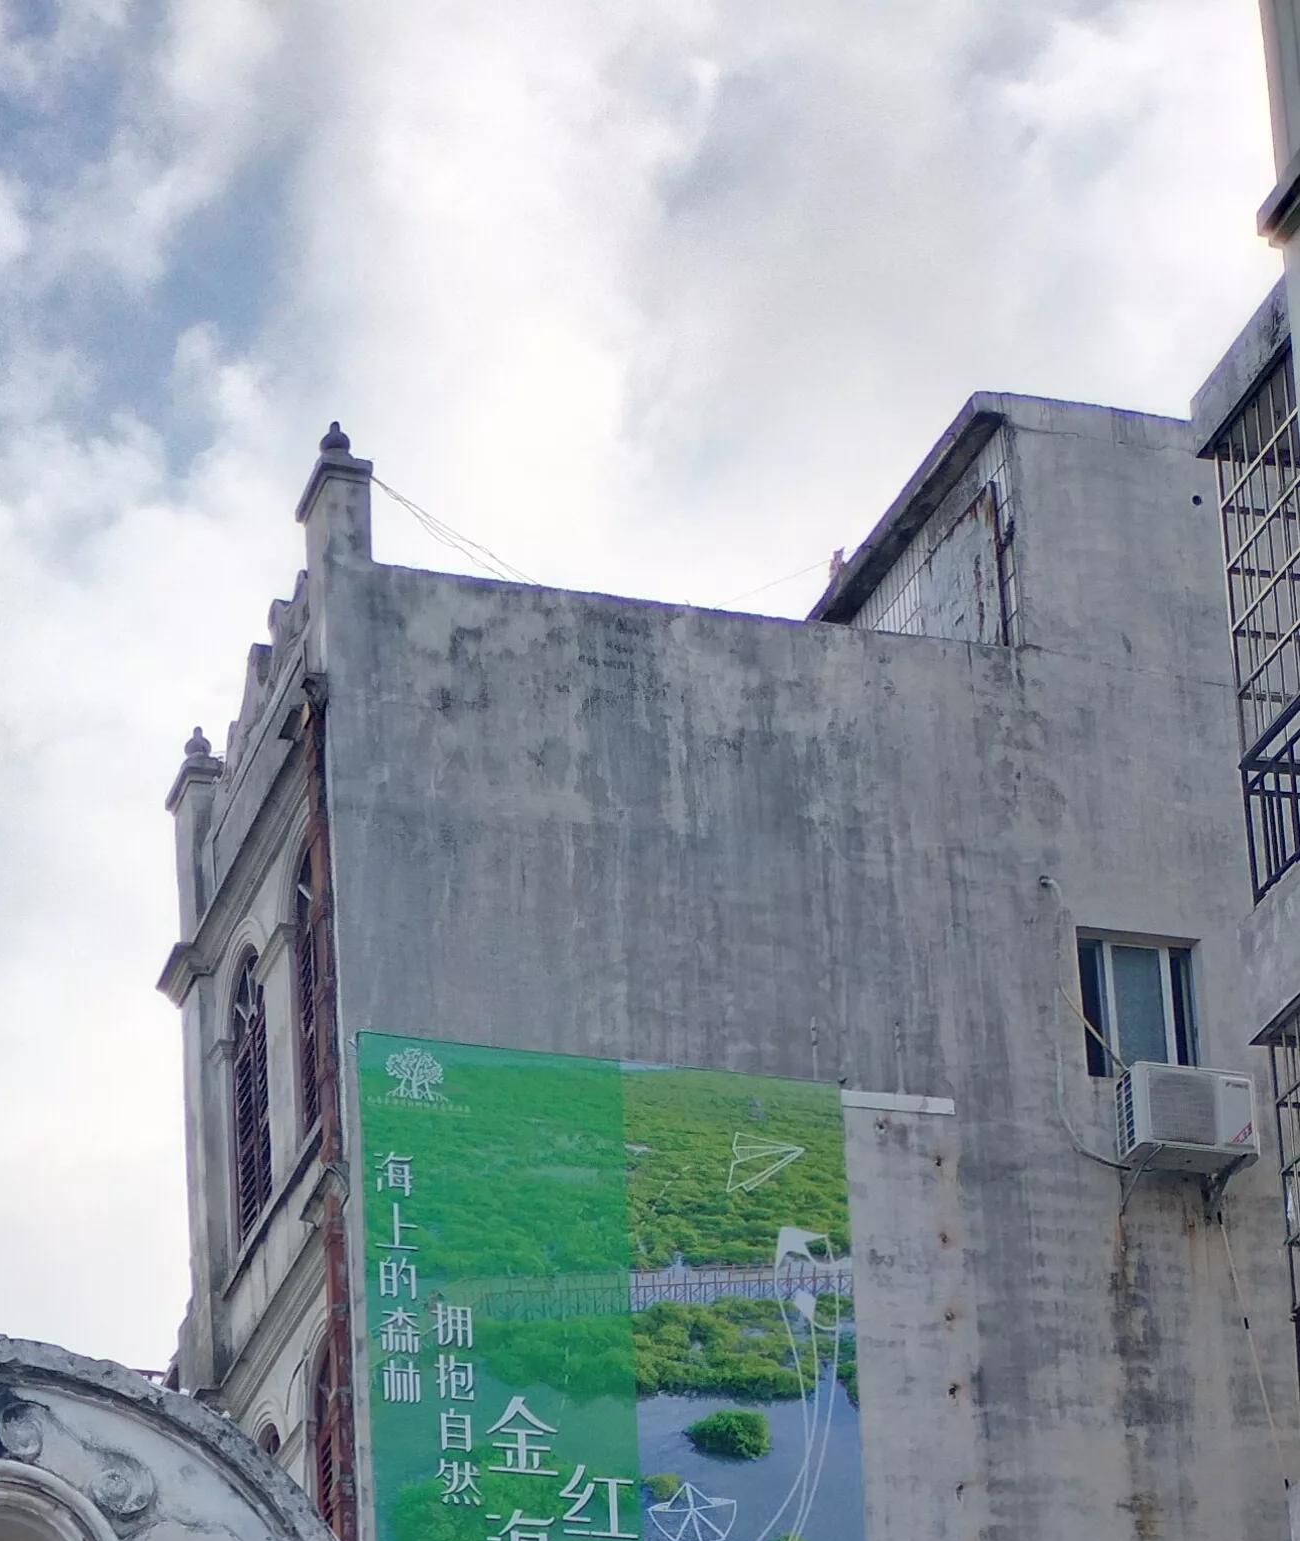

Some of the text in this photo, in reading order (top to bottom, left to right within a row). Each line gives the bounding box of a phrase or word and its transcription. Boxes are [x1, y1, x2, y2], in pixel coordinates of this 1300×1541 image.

[374, 1152, 420, 1402] 海上的森林
[431, 1303, 481, 1505] 拥抱自然
